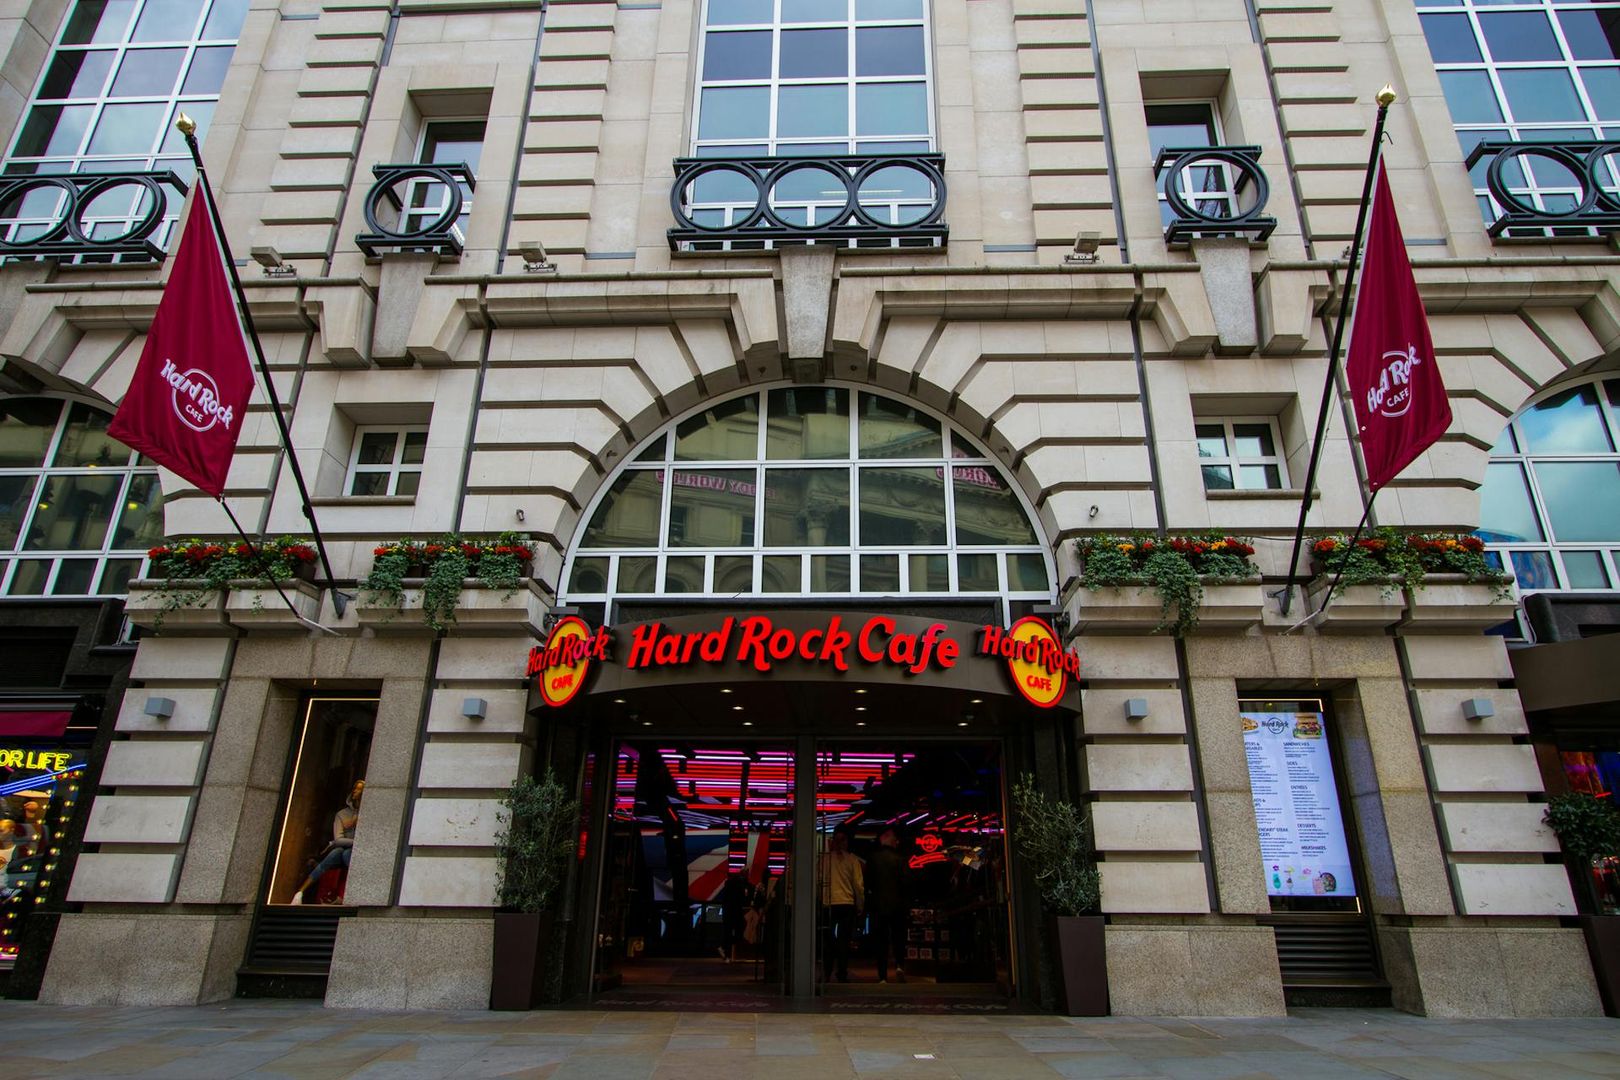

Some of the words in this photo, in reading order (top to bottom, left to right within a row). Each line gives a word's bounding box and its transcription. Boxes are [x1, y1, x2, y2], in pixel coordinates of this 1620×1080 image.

[160, 358, 203, 400] Hard
[198, 387, 233, 429] Rock
[1386, 387, 1409, 407] CAFE
[185, 404, 204, 422] CAFE
[525, 636, 563, 677] Hard
[561, 625, 610, 668] Rock
[626, 616, 736, 670] Hard
[736, 615, 850, 671] Rock
[858, 616, 960, 674] Cafe
[981, 624, 1040, 664] Hard
[1040, 637, 1081, 682] Rock
[551, 674, 574, 691] CAFE
[1026, 675, 1052, 691] CAFE
[26, 751, 70, 771] LIFE
